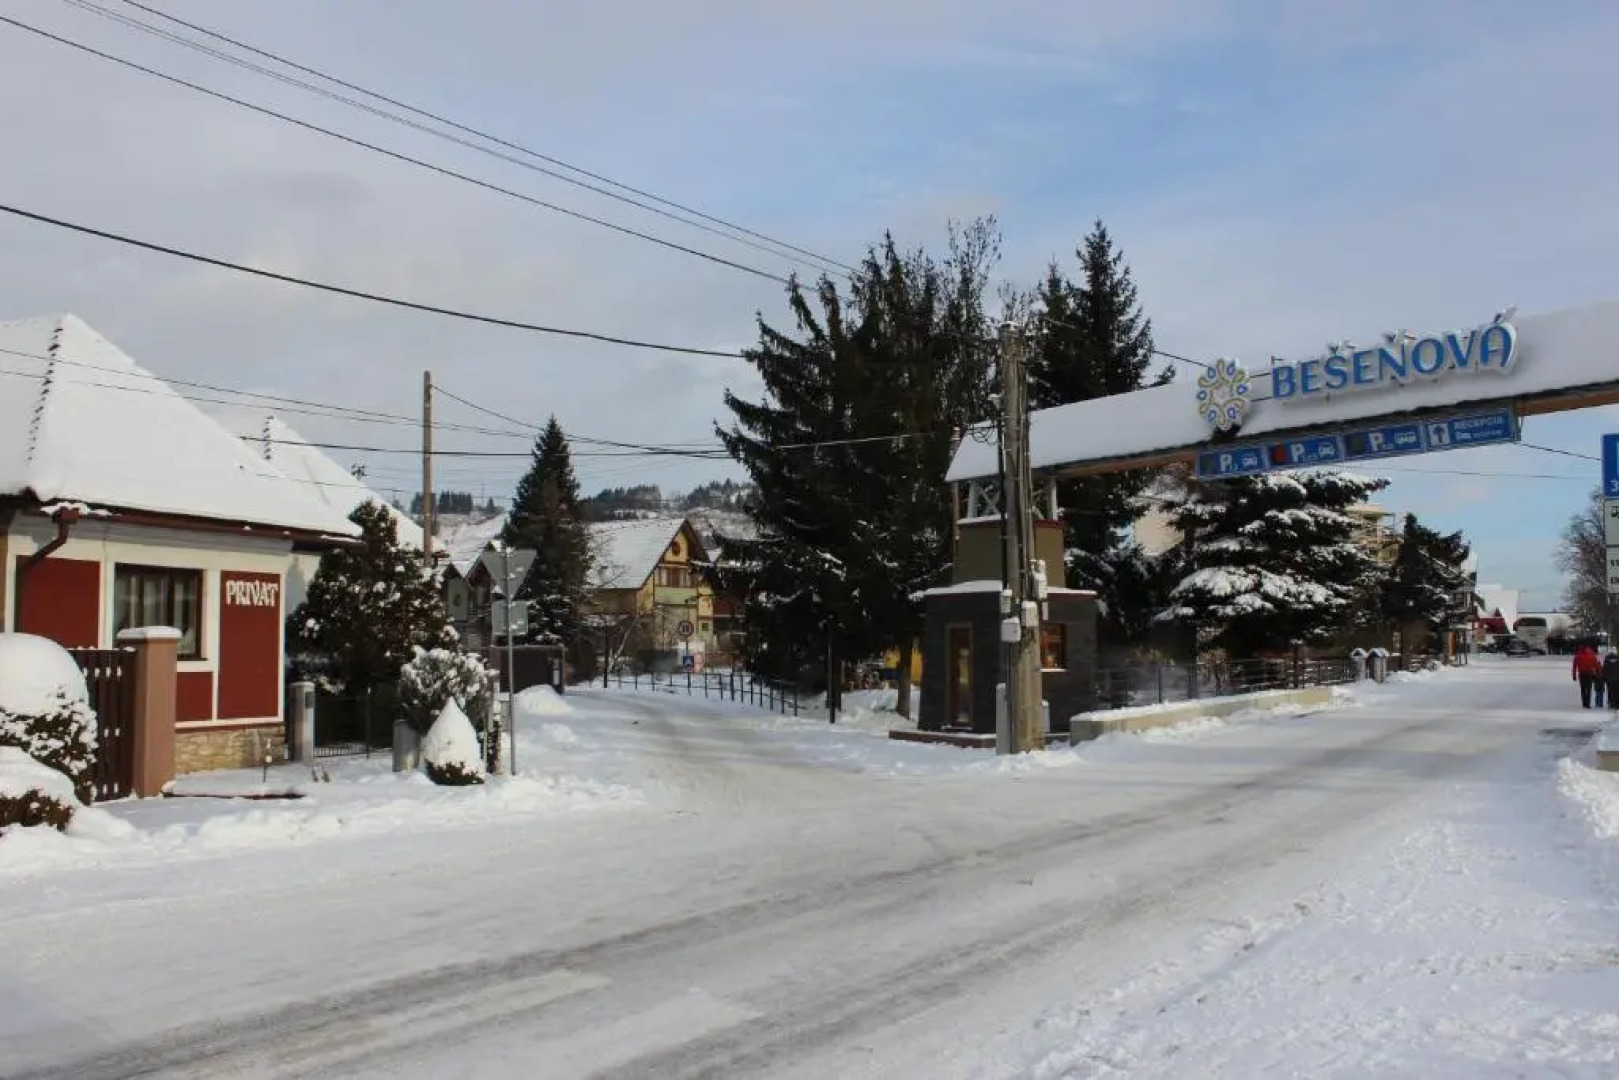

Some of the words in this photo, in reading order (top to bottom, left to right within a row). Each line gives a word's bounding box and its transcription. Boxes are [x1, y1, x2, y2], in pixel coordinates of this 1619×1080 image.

[1271, 307, 1516, 398] BEŠEŇOVÁ
[1369, 432, 1385, 451] P
[1220, 453, 1233, 471] P
[1290, 443, 1305, 462] P
